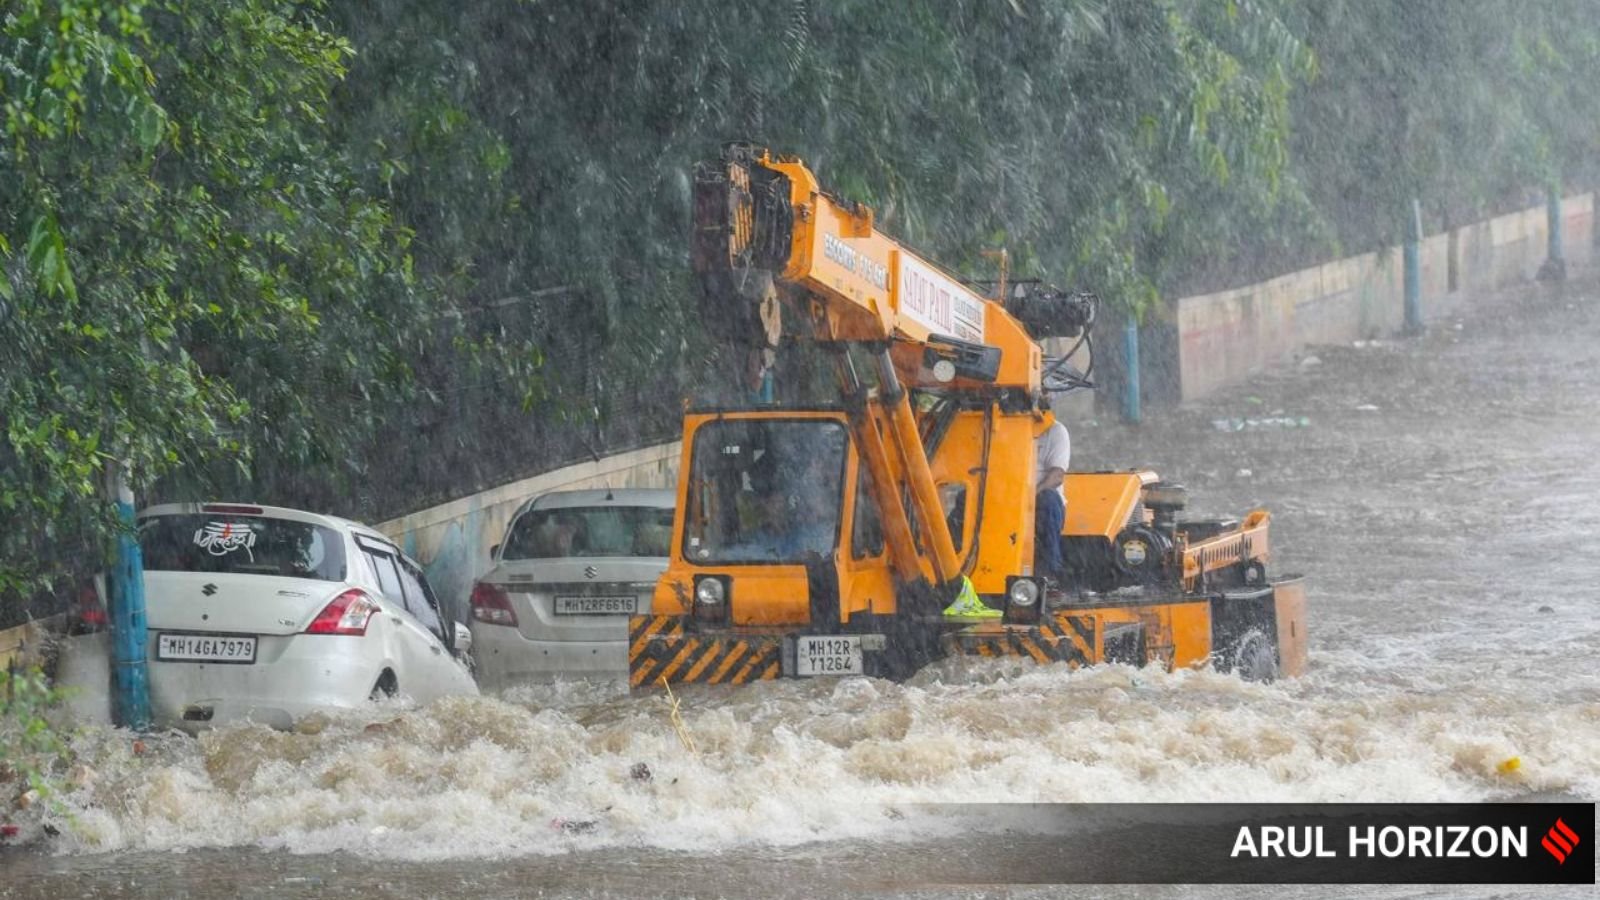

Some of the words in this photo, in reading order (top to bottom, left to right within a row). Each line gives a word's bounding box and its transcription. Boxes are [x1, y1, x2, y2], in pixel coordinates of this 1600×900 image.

[169, 639, 252, 656] MH14GA7979
[808, 640, 850, 656] MH12R
[809, 656, 852, 671] Y1264
